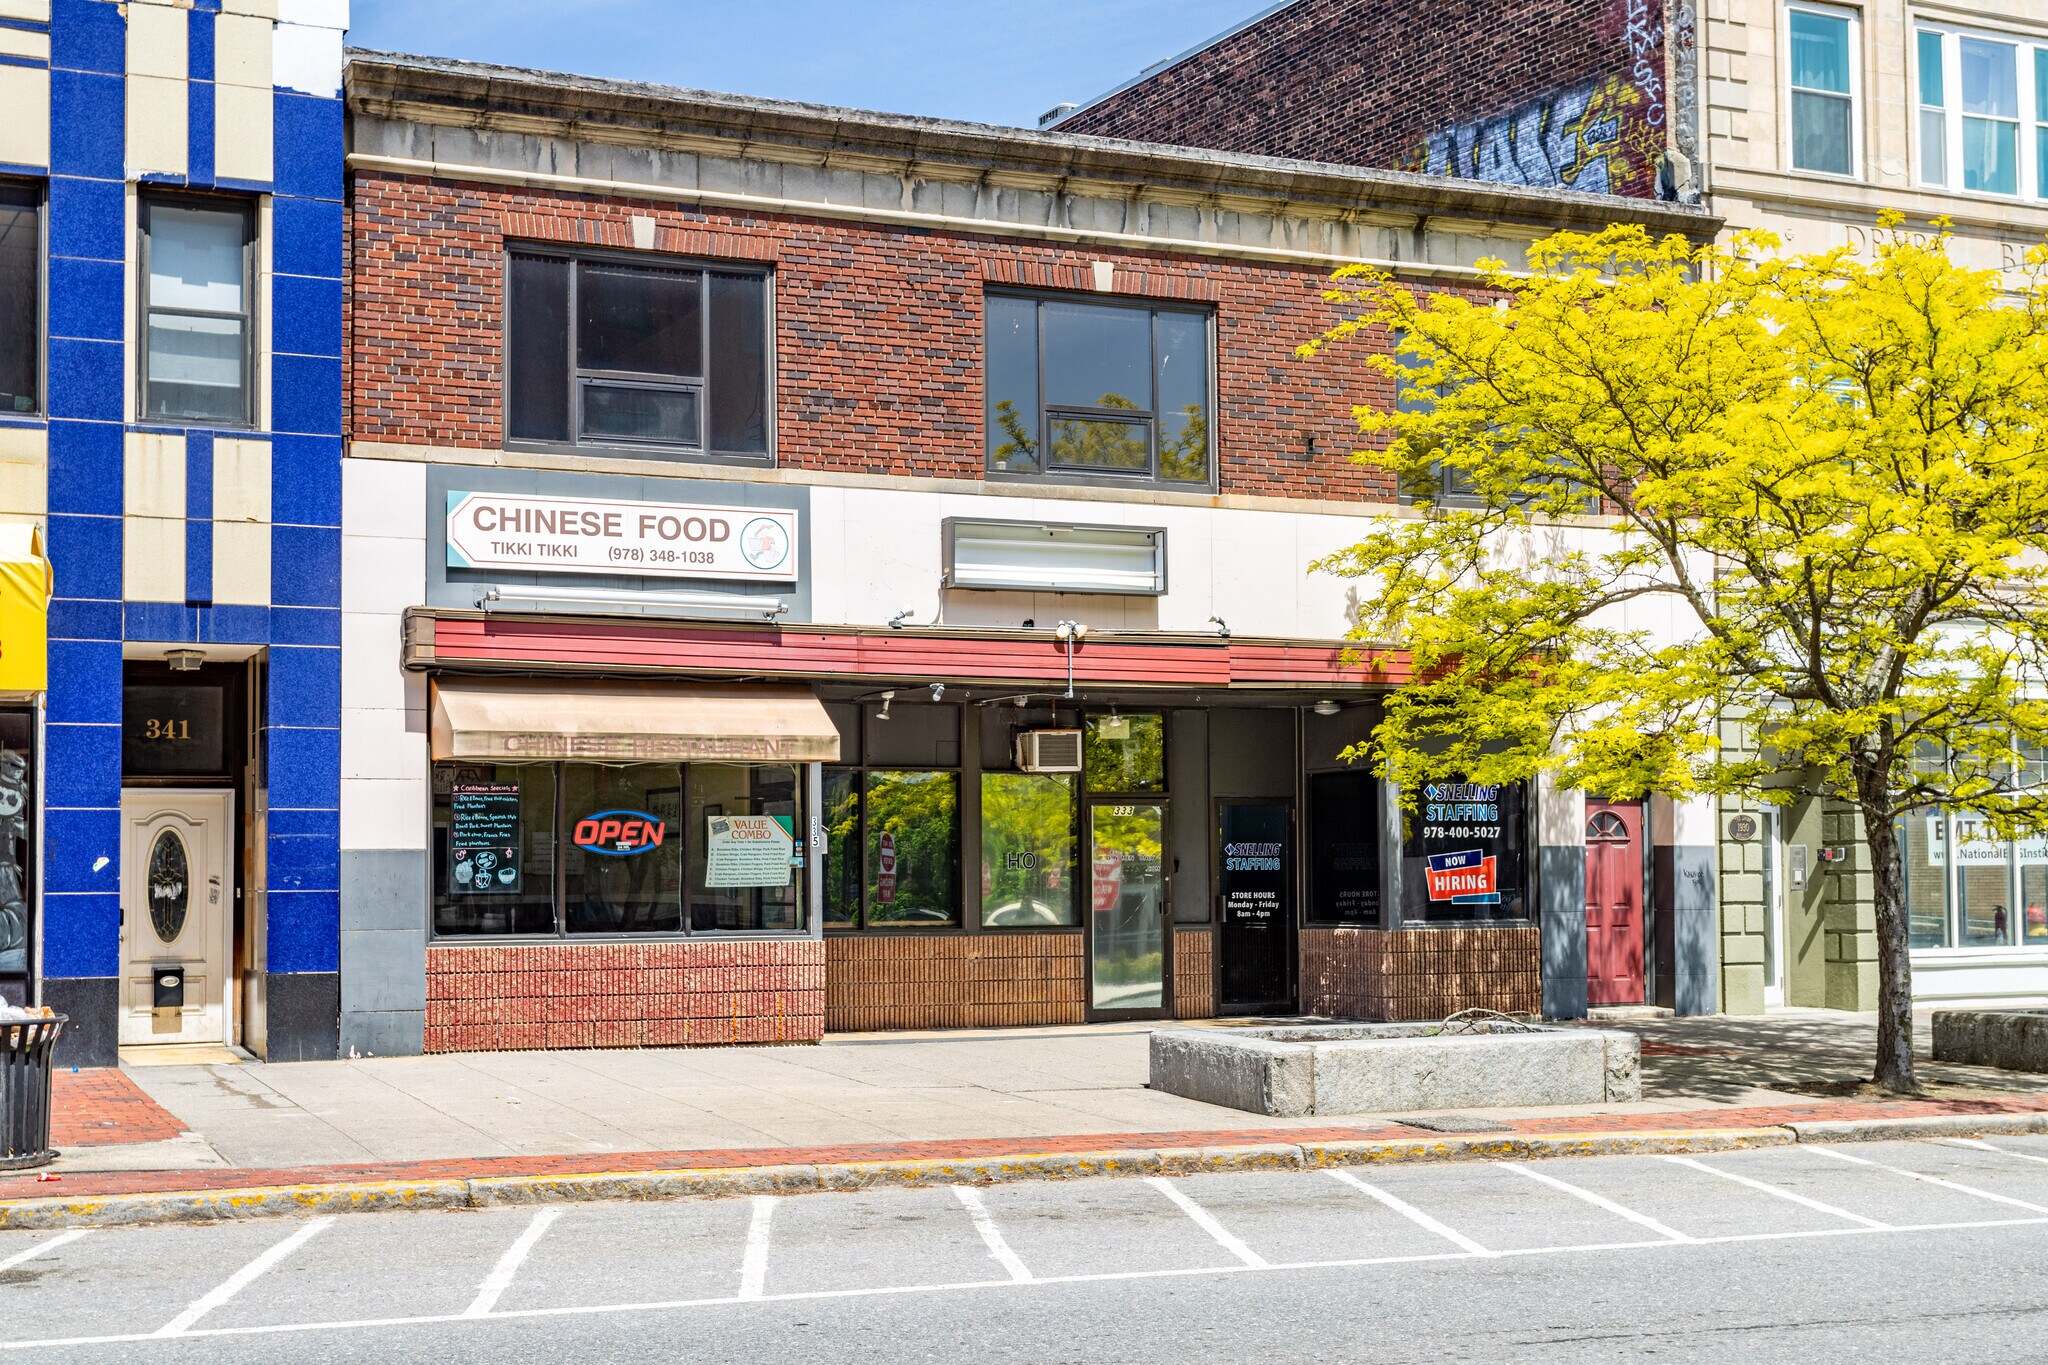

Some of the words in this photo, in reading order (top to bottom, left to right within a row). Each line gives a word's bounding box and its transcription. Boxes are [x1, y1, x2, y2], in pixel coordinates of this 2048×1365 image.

[472, 505, 623, 538] CHINESE
[638, 514, 731, 543] FOOD
[491, 541, 532, 556] TIKKI
[539, 543, 578, 558] TIKKI
[608, 546, 644, 563] (978)
[649, 549, 715, 565] 348-1038
[145, 718, 191, 740] 341
[503, 735, 620, 754] CHINESE
[632, 738, 796, 757] RESTAURANT
[1437, 783, 1497, 802] SNELLING
[1114, 806, 1134, 815] 333
[1426, 804, 1498, 822] STAFFING
[573, 819, 666, 846] OPEN
[734, 820, 768, 830] VALUE
[1424, 826, 1500, 839] 978-400-5027
[731, 830, 771, 840] COMBO
[1233, 843, 1280, 856] SNELLING
[1007, 851, 1036, 870] HO
[1226, 858, 1281, 871] STAFFING
[1445, 855, 1466, 868] NOW
[1435, 874, 1487, 891] HIRING
[1227, 901, 1253, 909] Monday
[1259, 901, 1279, 909] Friday
[1256, 910, 1271, 918] 4pm
